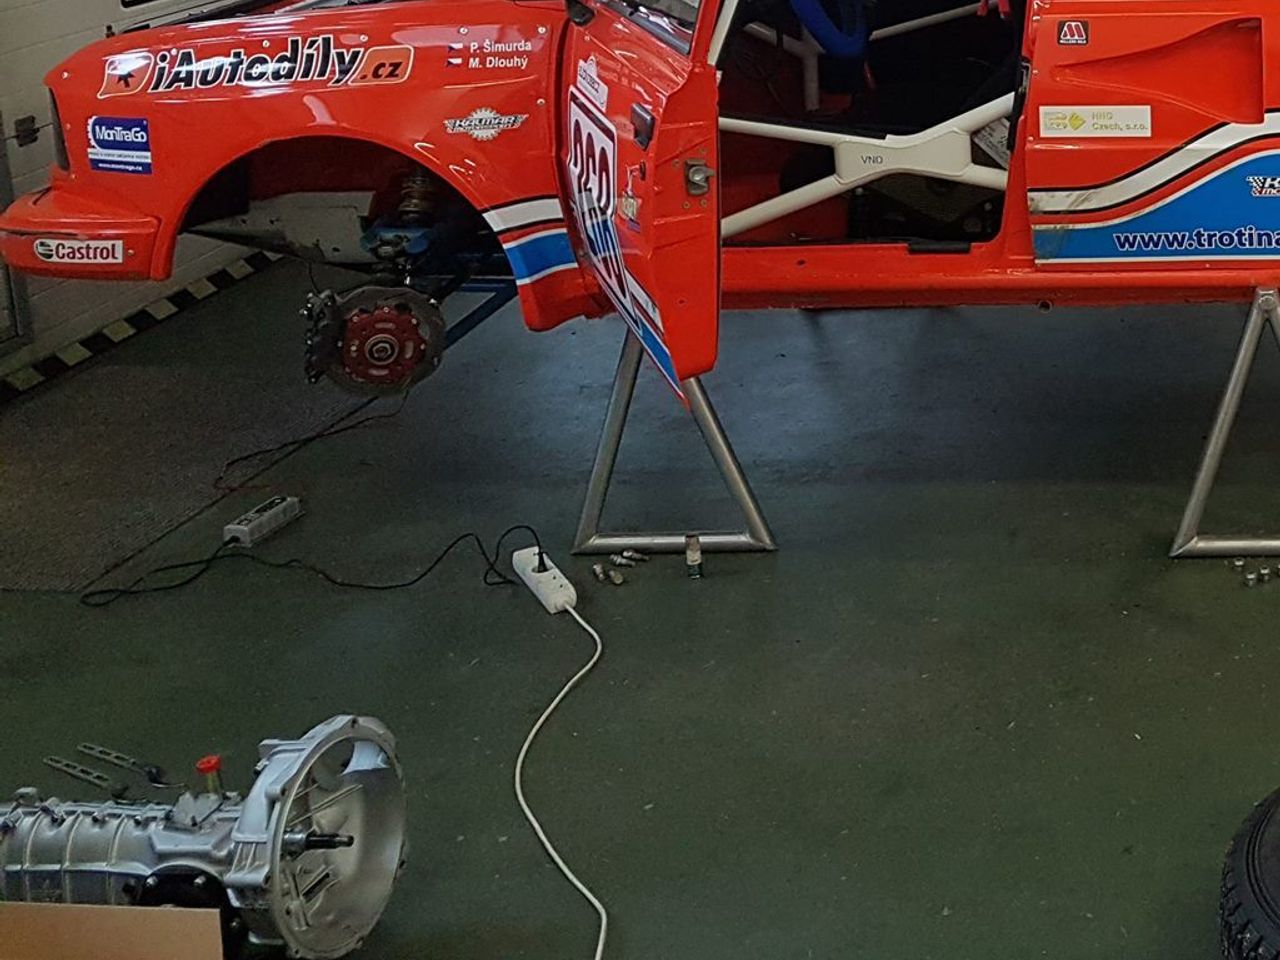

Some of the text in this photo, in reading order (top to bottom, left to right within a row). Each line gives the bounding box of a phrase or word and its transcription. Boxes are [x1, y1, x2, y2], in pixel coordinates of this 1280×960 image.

[470, 42, 480, 53] P.
[468, 55, 529, 70] M. Dlouhý
[55, 243, 118, 260] Castrol
